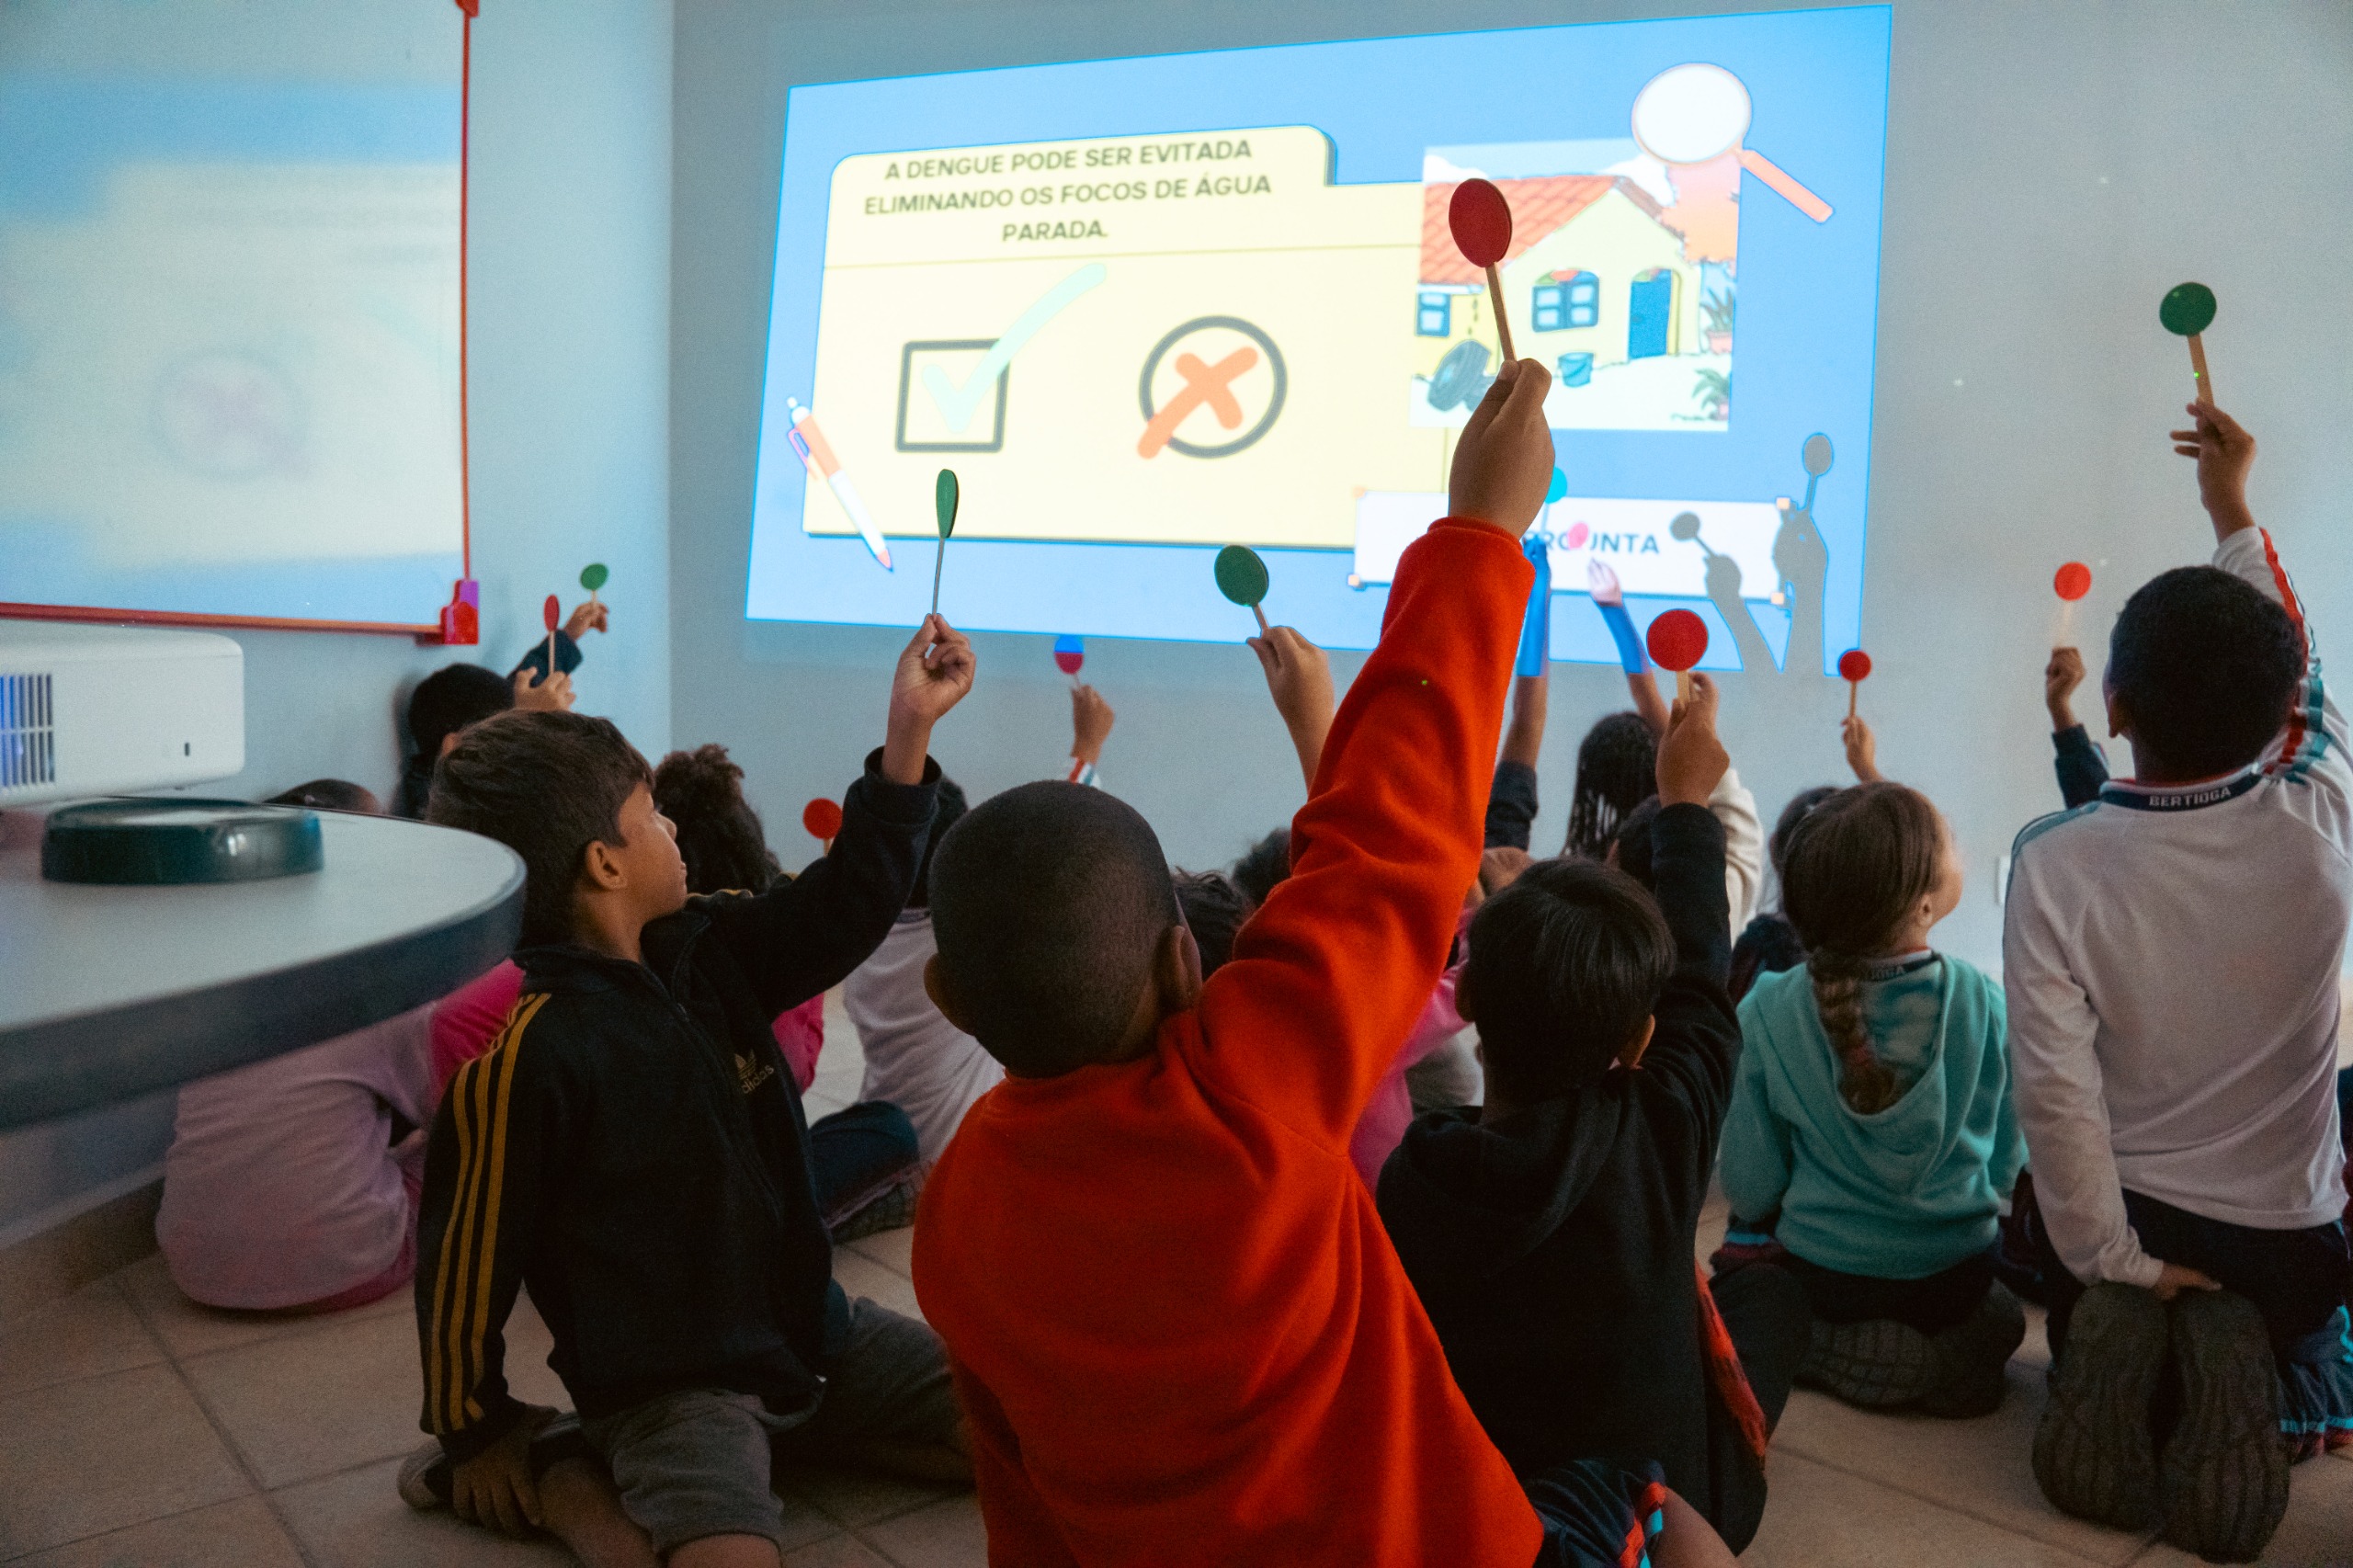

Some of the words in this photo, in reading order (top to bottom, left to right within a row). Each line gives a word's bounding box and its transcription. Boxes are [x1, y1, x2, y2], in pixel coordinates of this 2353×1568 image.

[884, 162, 901, 180] A
[906, 154, 1005, 179] DENGUE
[1011, 150, 1078, 172] PODE
[1085, 146, 1132, 167] SER
[1140, 139, 1253, 165] EVITADA
[864, 188, 1013, 215] ELIMINANDO
[1020, 187, 1053, 206] OS
[1061, 181, 1148, 203] FOCOS
[1154, 177, 1188, 199] DE
[1194, 172, 1272, 198] ÁGUA
[1002, 220, 1108, 242] PARADA.
[2148, 786, 2233, 808] BERTIOGA
[741, 1064, 775, 1095] didas
